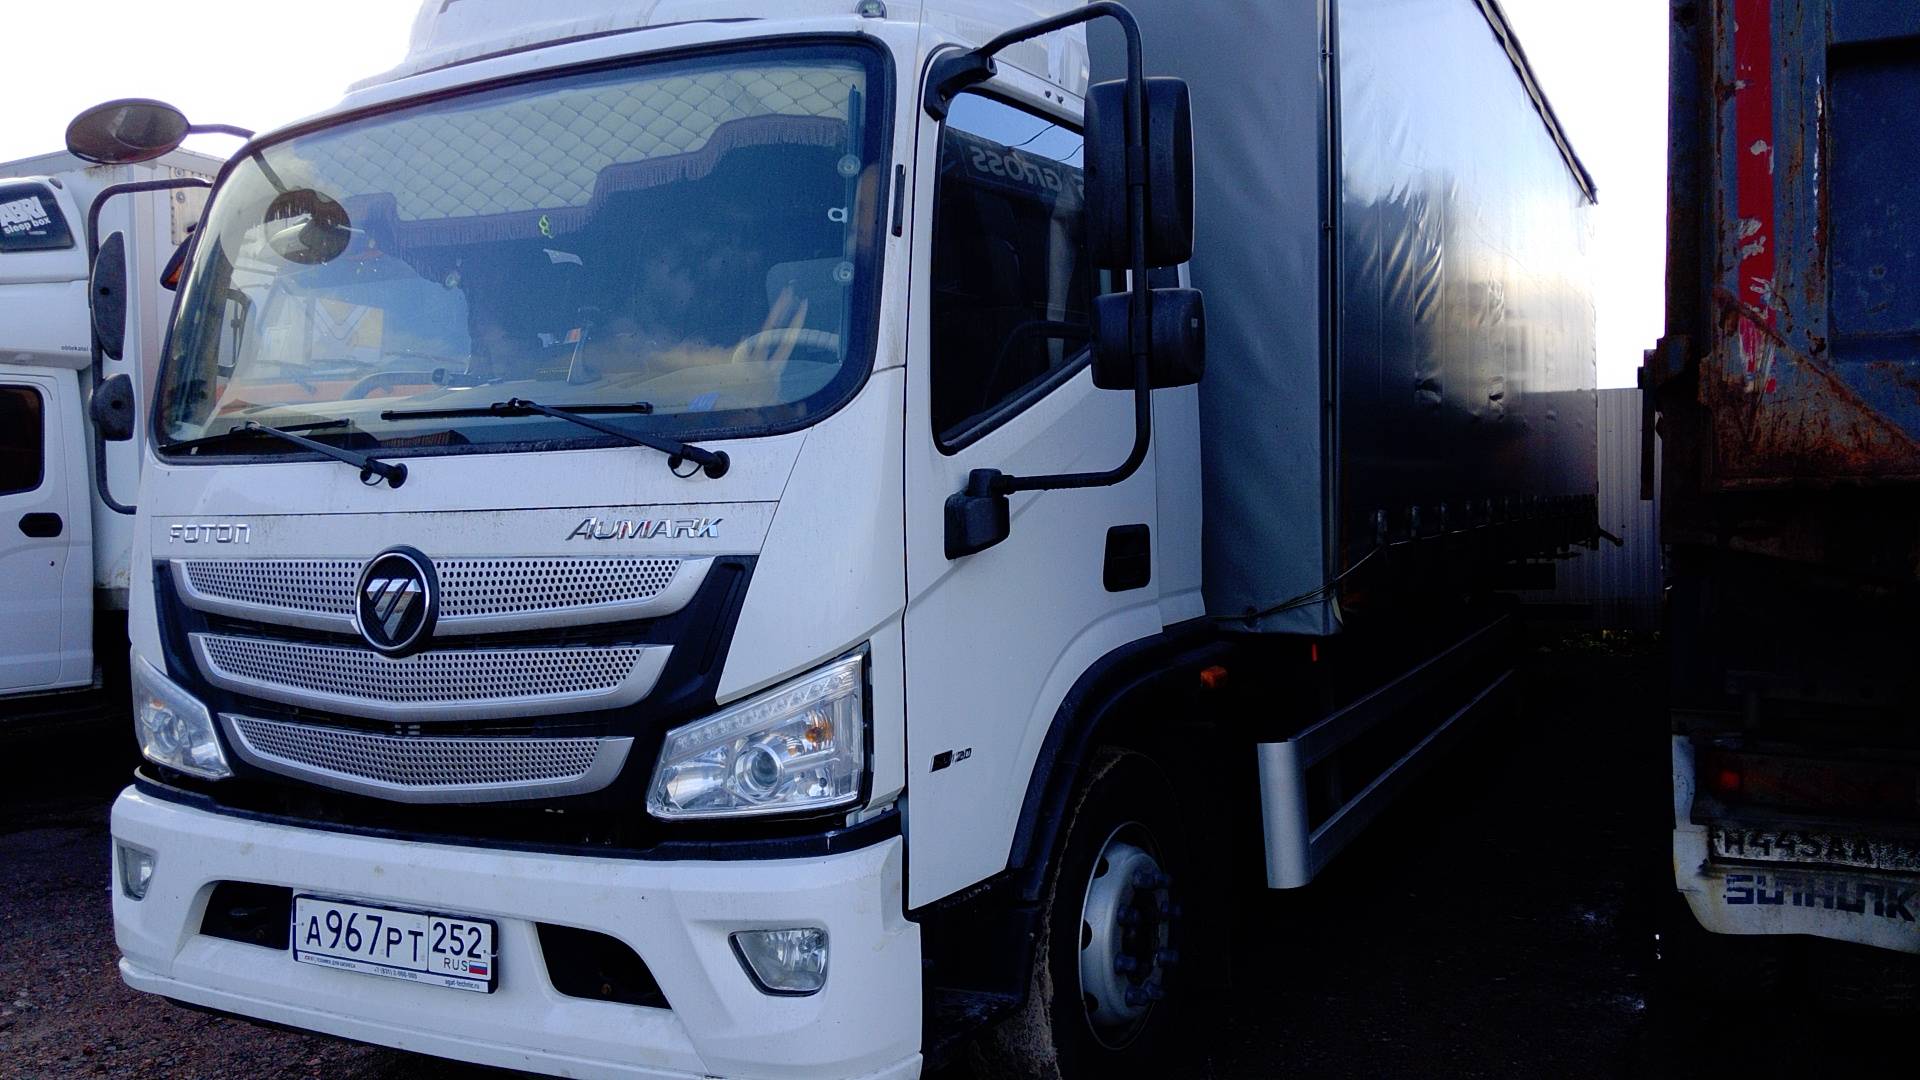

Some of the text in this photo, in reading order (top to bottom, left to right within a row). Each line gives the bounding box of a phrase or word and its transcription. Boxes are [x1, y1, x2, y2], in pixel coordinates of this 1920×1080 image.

[32, 216, 51, 227] box
[169, 523, 251, 544] FOTON
[565, 517, 724, 541] AUMARK
[432, 921, 482, 958] 252
[443, 957, 468, 971] RUS
